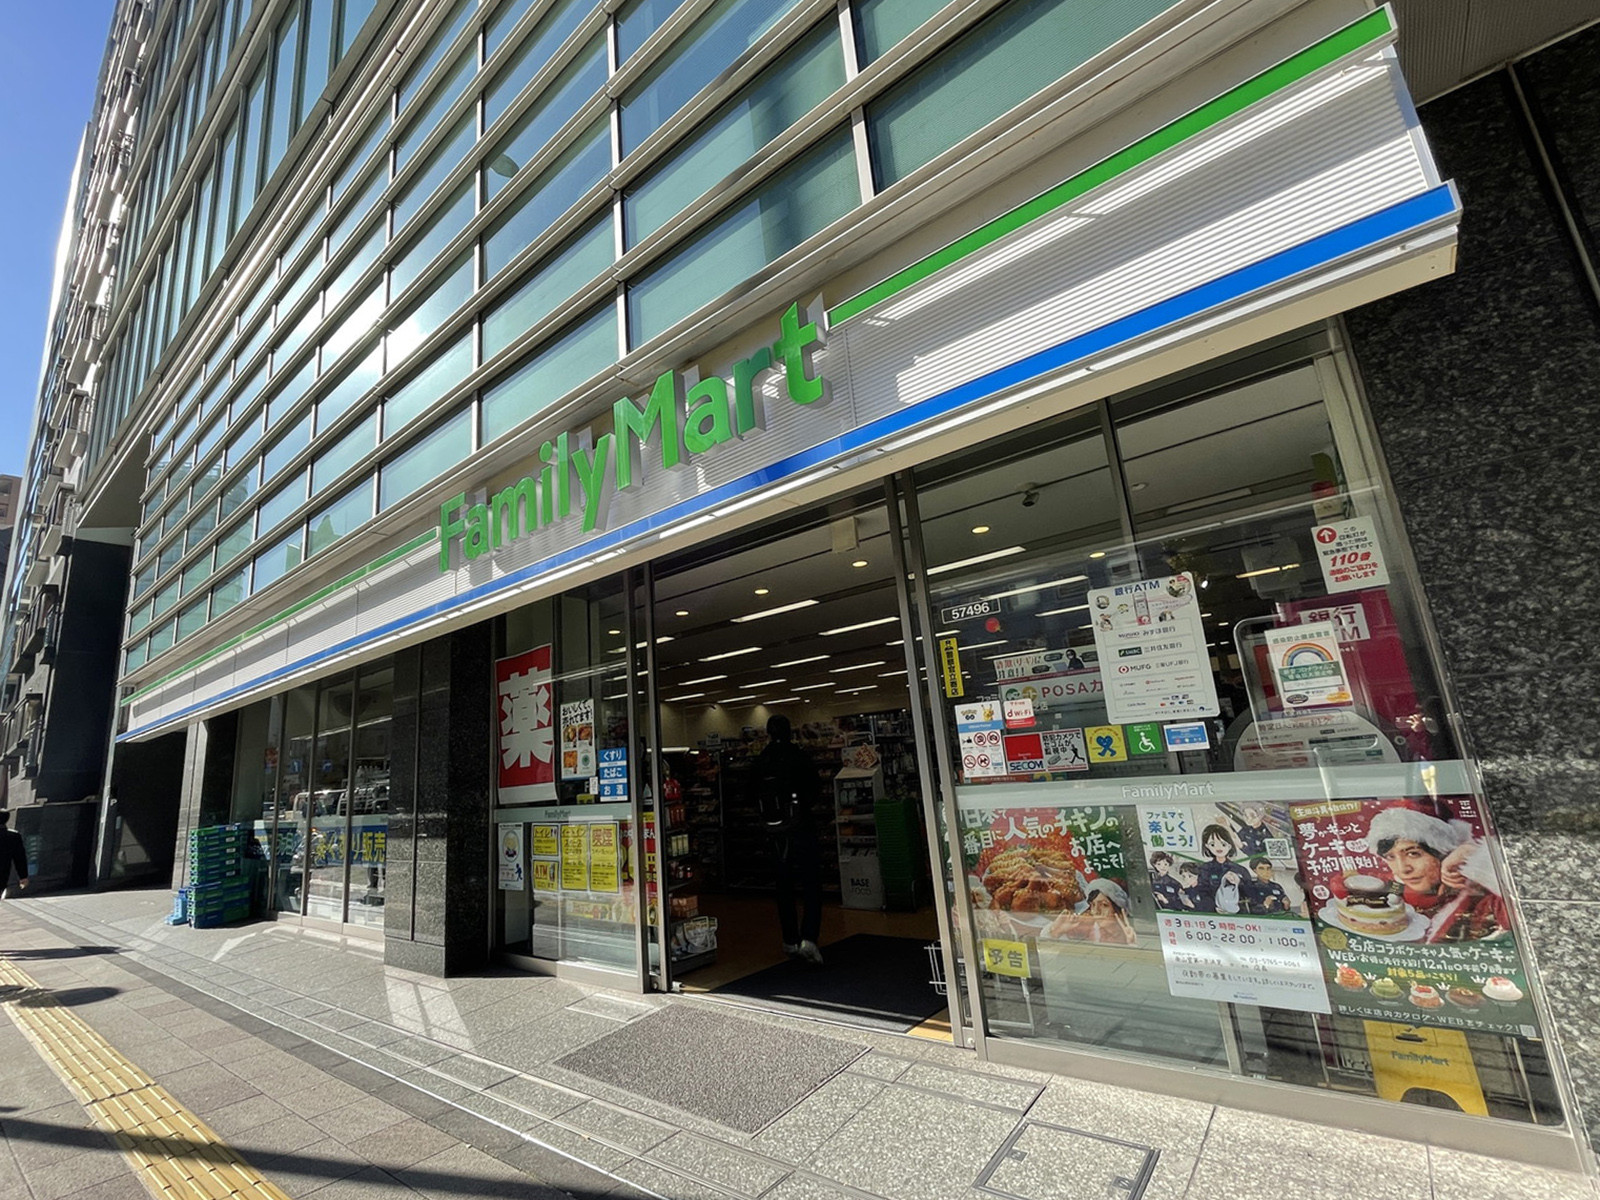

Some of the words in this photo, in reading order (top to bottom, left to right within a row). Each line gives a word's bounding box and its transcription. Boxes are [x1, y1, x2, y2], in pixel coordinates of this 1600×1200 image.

[440, 301, 825, 572] FamilyMart
[1330, 551, 1372, 567] 110番
[1114, 580, 1160, 596] 銀行ATM
[951, 602, 990, 620] 57496
[1130, 662, 1152, 671] MUFG
[499, 667, 552, 769] 薬
[604, 749, 622, 761] くすり
[604, 767, 623, 778] たばこ
[1009, 760, 1044, 771] SECOM
[1121, 781, 1214, 800] FamilyMart
[1148, 821, 1187, 833] 楽しく
[1069, 832, 1121, 858] お店へ
[1151, 835, 1193, 848] 働こう!
[1302, 838, 1345, 859] ケーキ
[1083, 852, 1125, 874] ようこそ!
[1306, 856, 1379, 877] 予約開始!
[535, 864, 548, 880] ATM
[988, 947, 1023, 969] 予告
[1391, 1050, 1450, 1067] FamilyMart
